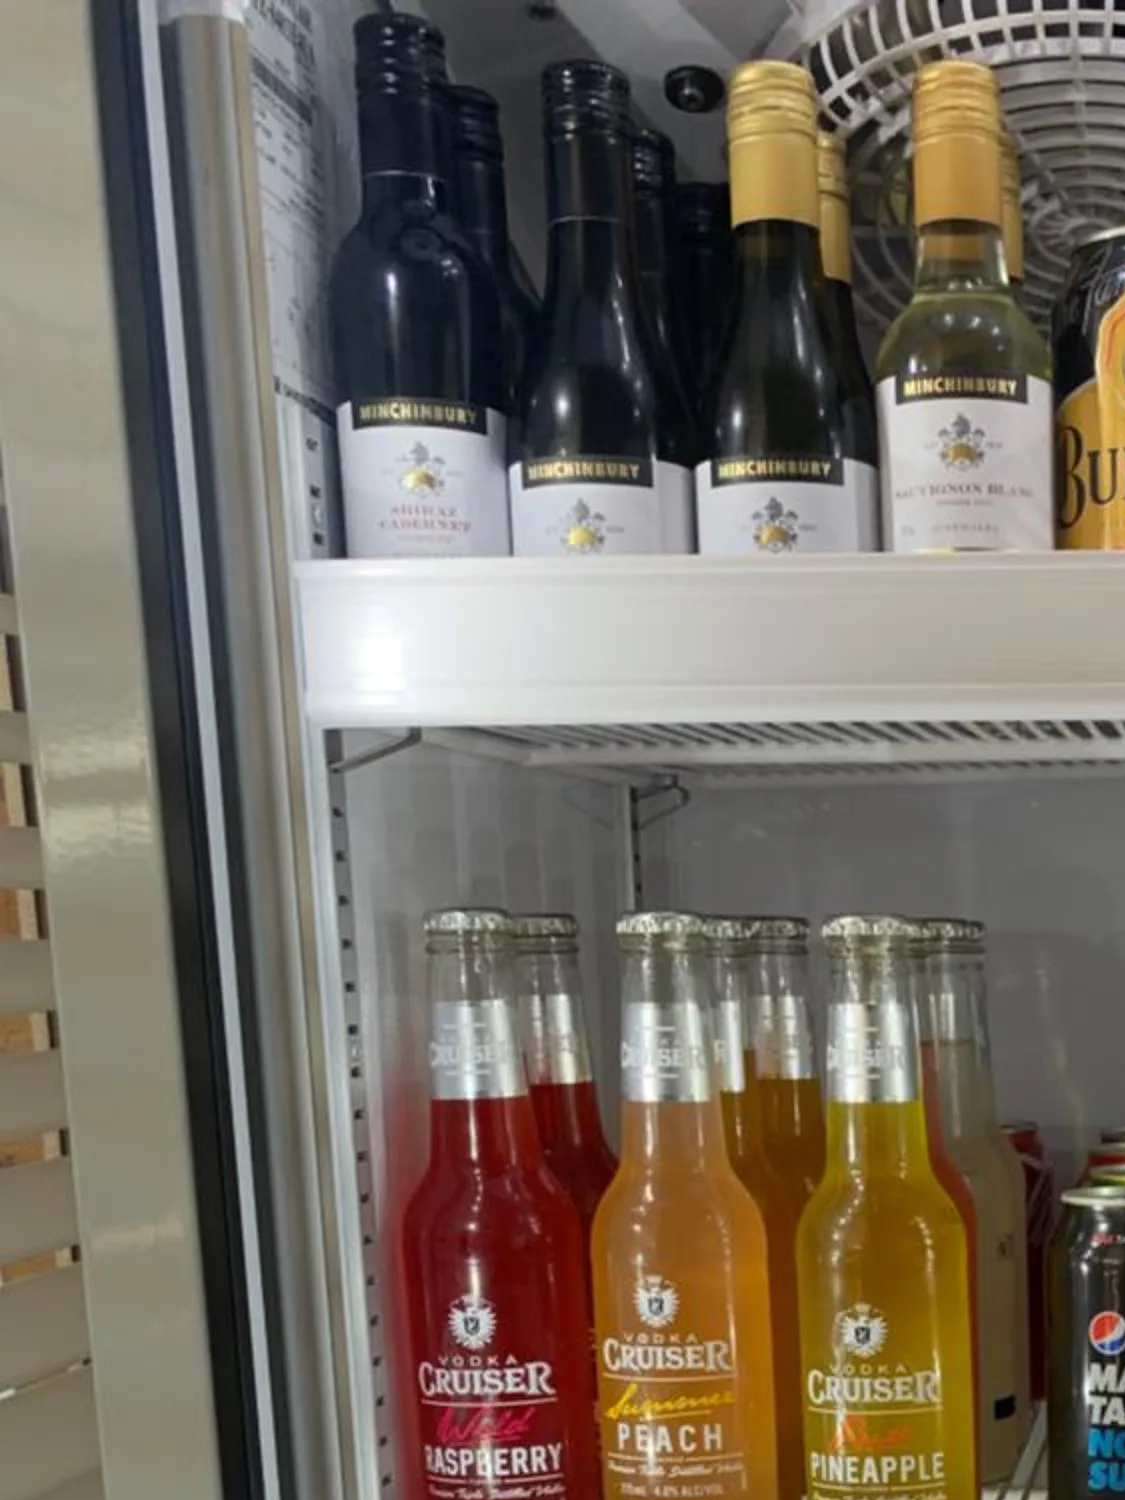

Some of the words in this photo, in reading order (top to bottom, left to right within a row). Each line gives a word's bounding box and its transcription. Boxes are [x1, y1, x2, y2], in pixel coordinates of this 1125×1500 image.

[904, 376, 1017, 397] MINCHINBURY
[359, 402, 477, 424] MINCHINBURY
[527, 463, 640, 481] MINCHINBURY
[718, 460, 832, 479] MINCHINBURY
[624, 1333, 699, 1344] VODKA
[438, 1355, 519, 1367] VODKA
[603, 1338, 733, 1373] CRUISER
[418, 1361, 557, 1396] CRUISER
[808, 1369, 943, 1404] CRUISER
[618, 1423, 723, 1452] PEACH
[426, 1443, 563, 1477] RASPBERRY
[811, 1451, 945, 1484] PINEAPPLE
